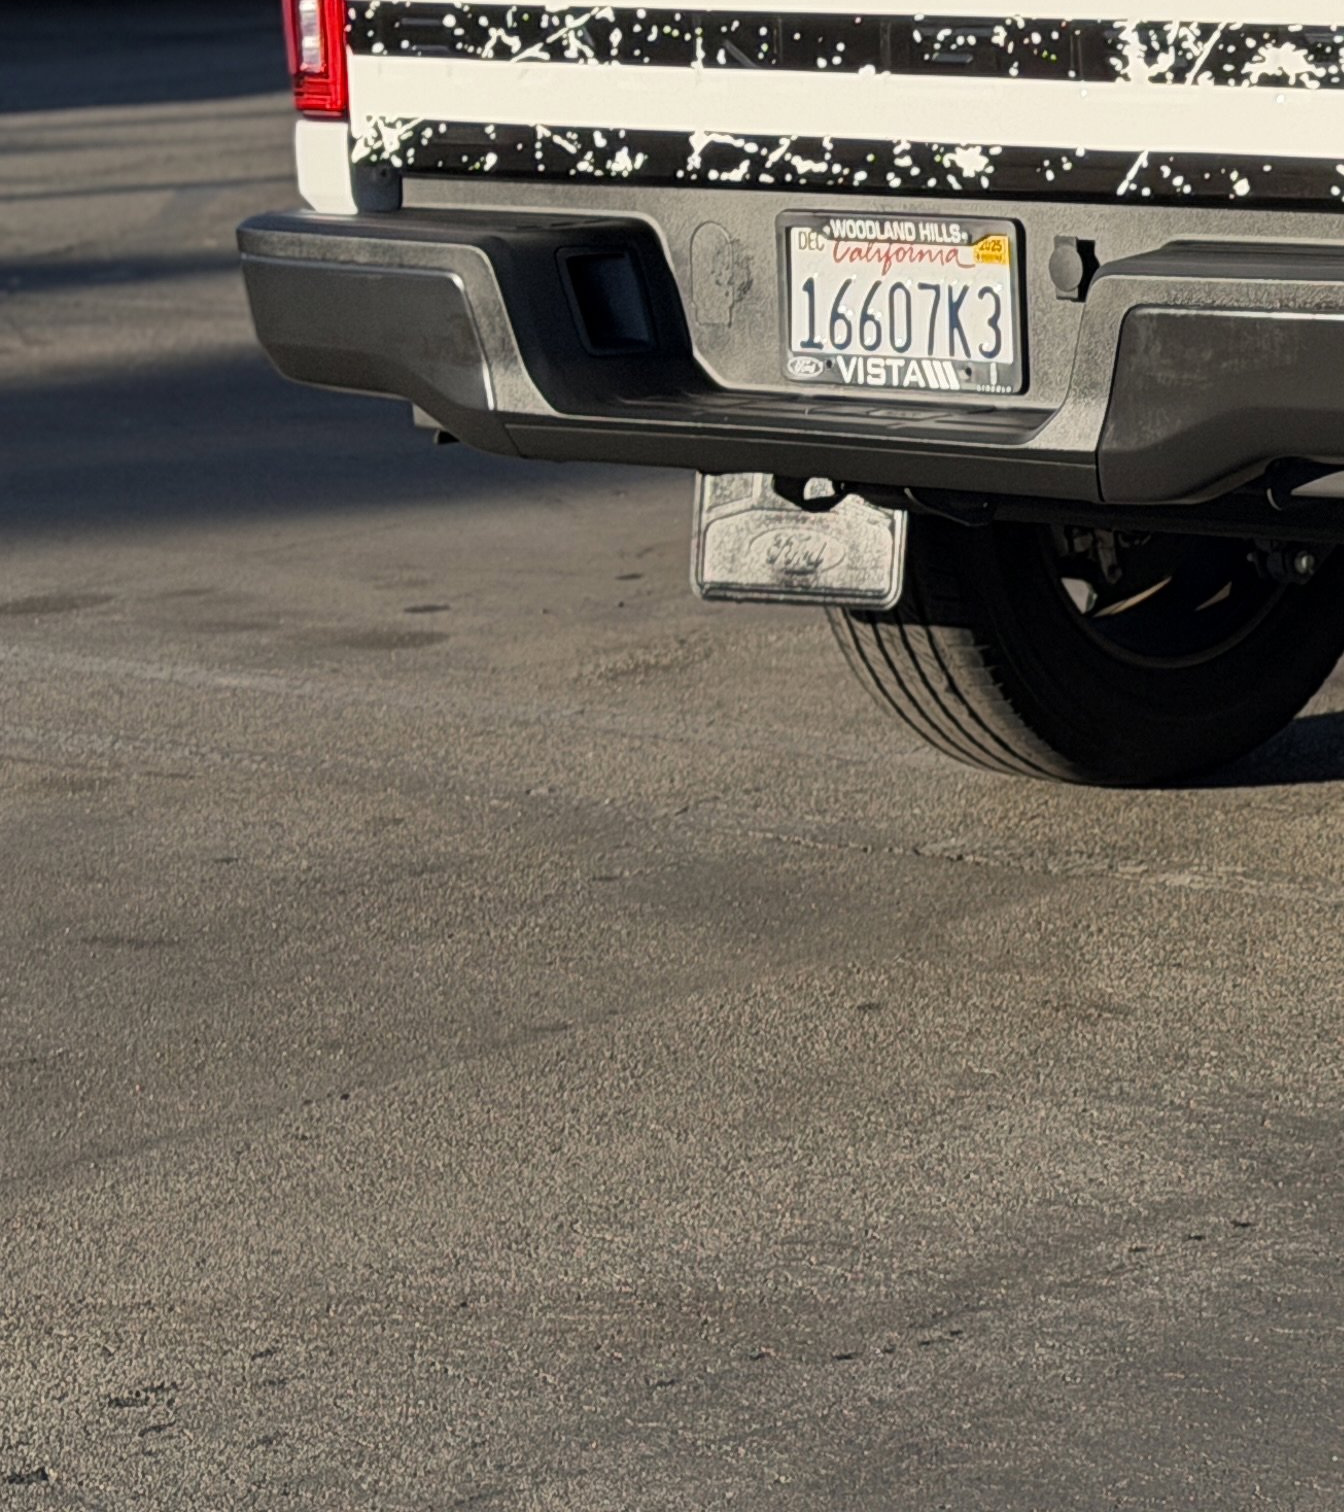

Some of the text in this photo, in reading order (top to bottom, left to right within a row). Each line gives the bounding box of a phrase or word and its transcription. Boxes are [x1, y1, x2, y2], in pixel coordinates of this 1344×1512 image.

[798, 231, 825, 251] DEC
[830, 218, 962, 243] WOODLAND HILLS
[832, 239, 976, 275] California
[799, 276, 1002, 359] 16607K3
[836, 355, 927, 388] VISTA
